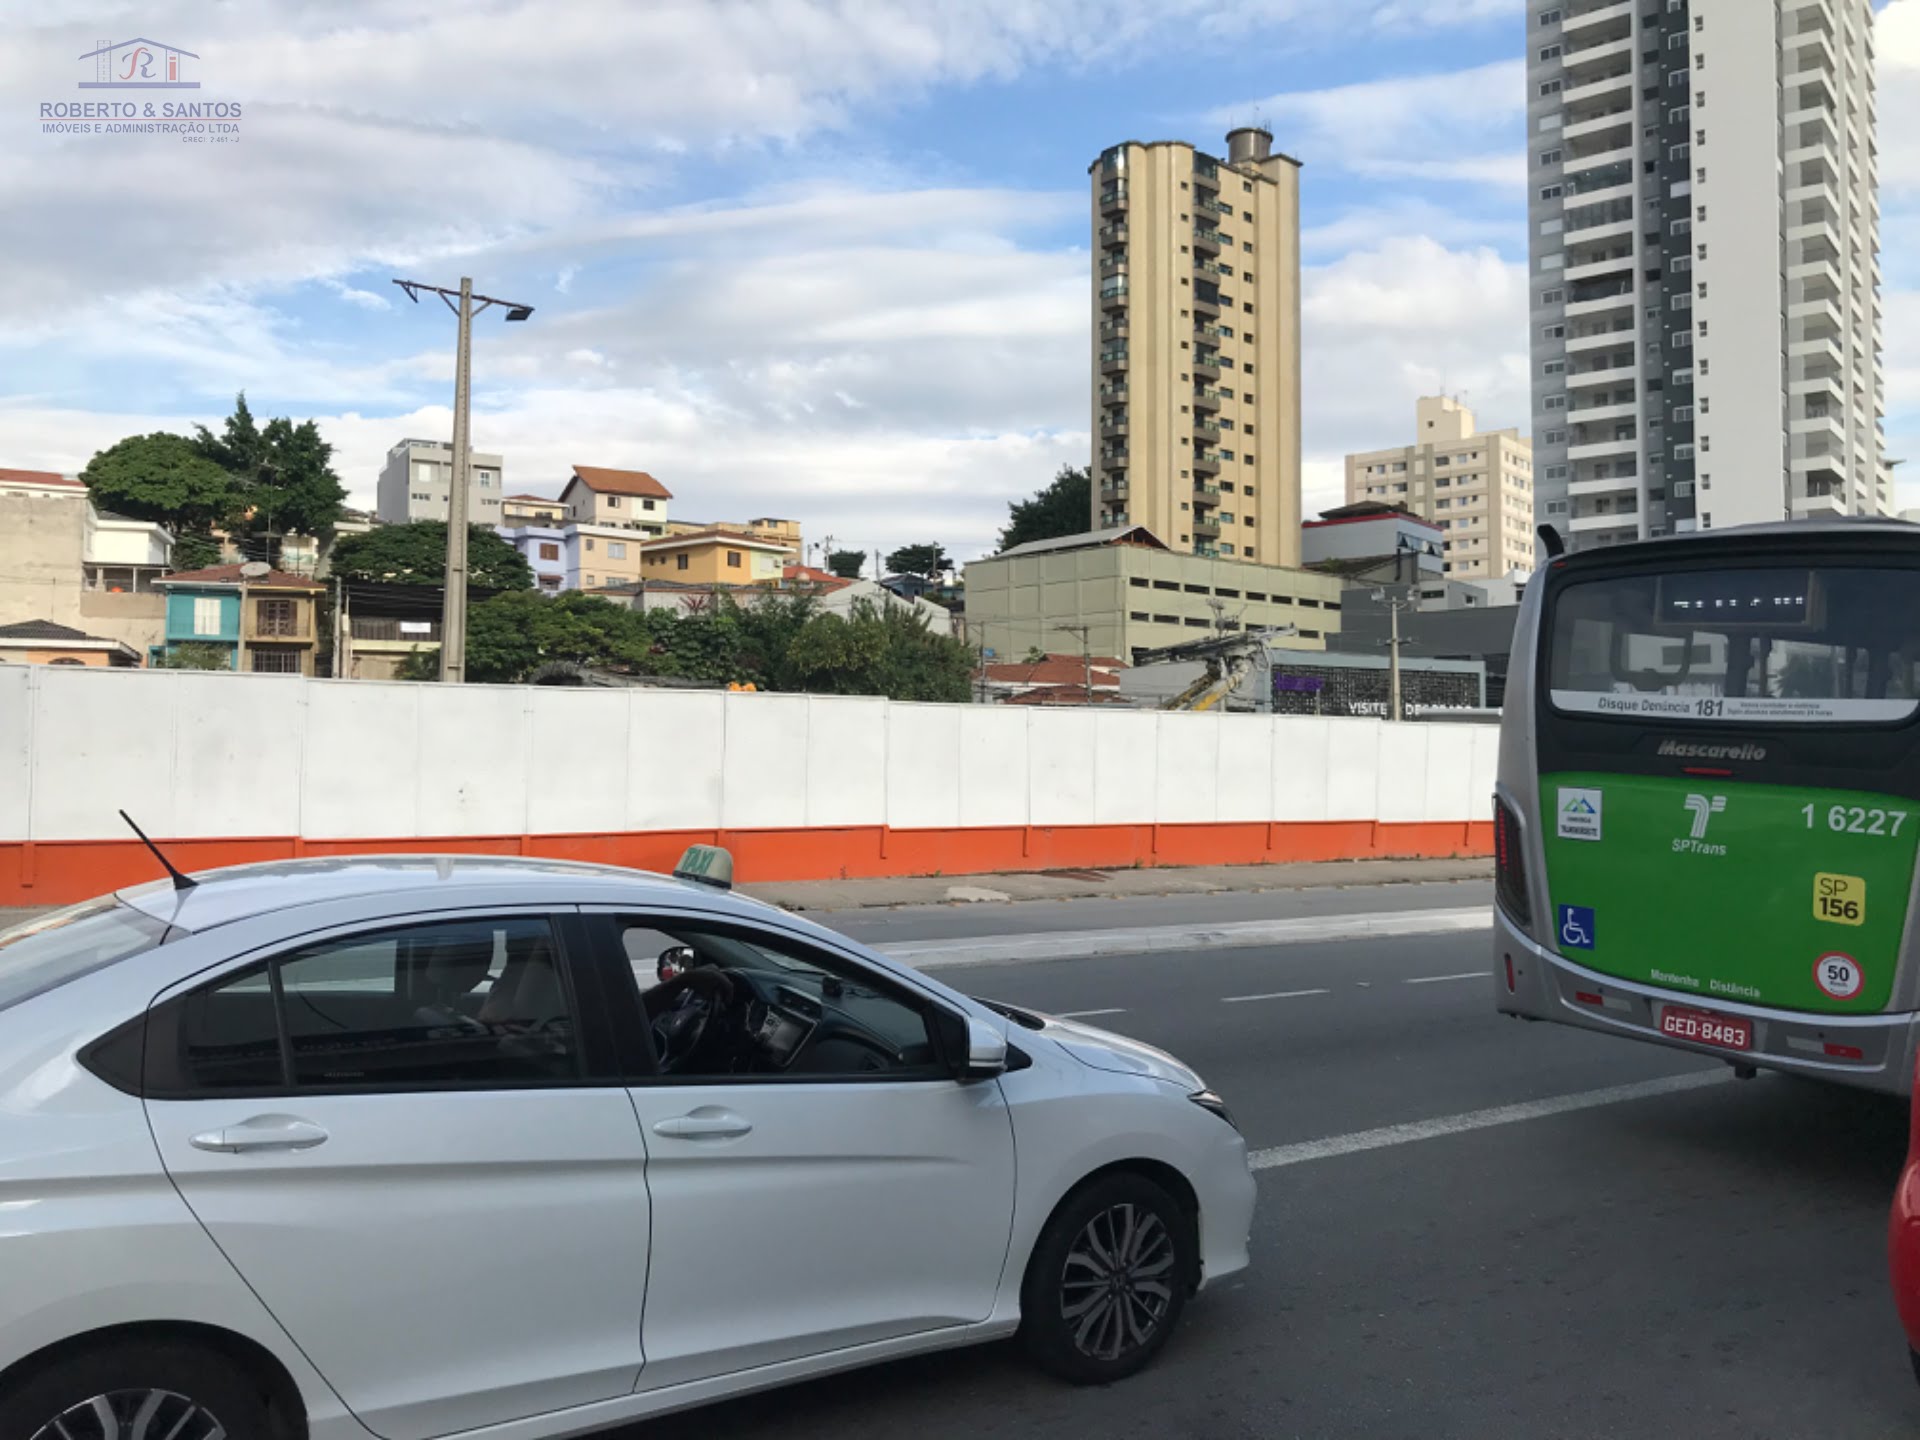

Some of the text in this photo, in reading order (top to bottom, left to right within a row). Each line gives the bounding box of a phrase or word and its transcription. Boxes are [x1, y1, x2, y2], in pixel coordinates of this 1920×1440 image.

[1348, 701, 1388, 716] VISITE
[1598, 697, 1639, 712] Disque
[1695, 699, 1724, 717] 181
[1657, 740, 1767, 761] Mascarello
[1801, 803, 1908, 837] 1 6227
[1672, 838, 1727, 856] SPTrans
[681, 847, 716, 875] TAXI
[1819, 877, 1849, 897] SP
[1819, 897, 1859, 920] 156
[1827, 965, 1850, 982] 50
[1663, 1015, 1746, 1047] GED-8483
